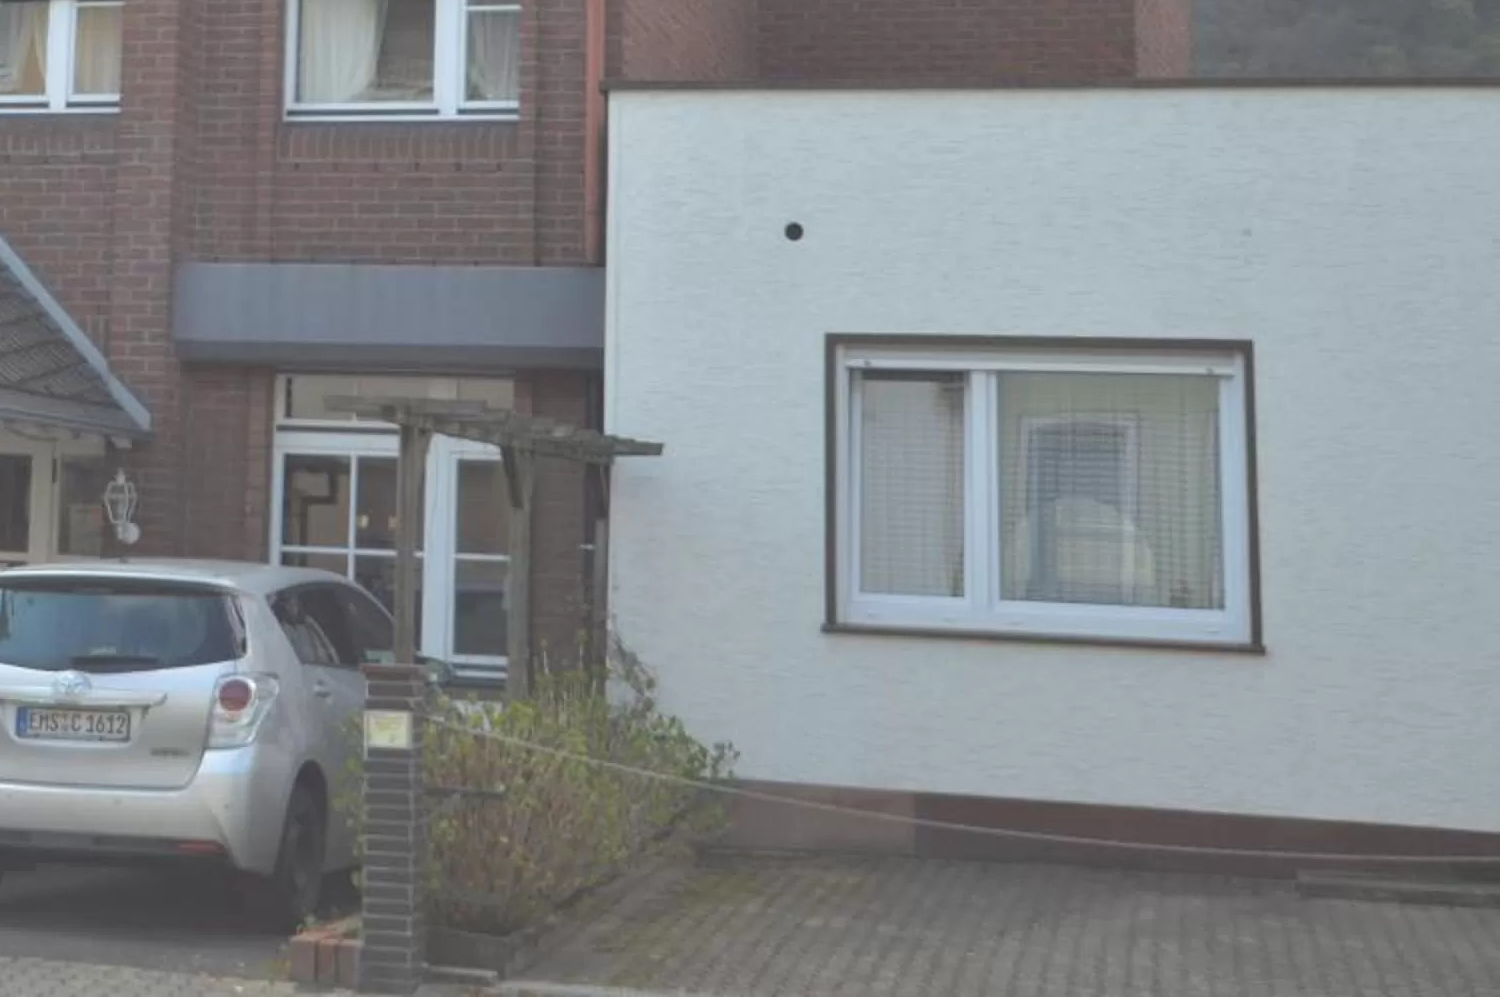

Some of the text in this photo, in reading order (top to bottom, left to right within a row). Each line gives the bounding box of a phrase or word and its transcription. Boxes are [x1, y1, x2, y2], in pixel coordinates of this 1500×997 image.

[30, 711, 127, 735] EMS C 1612
